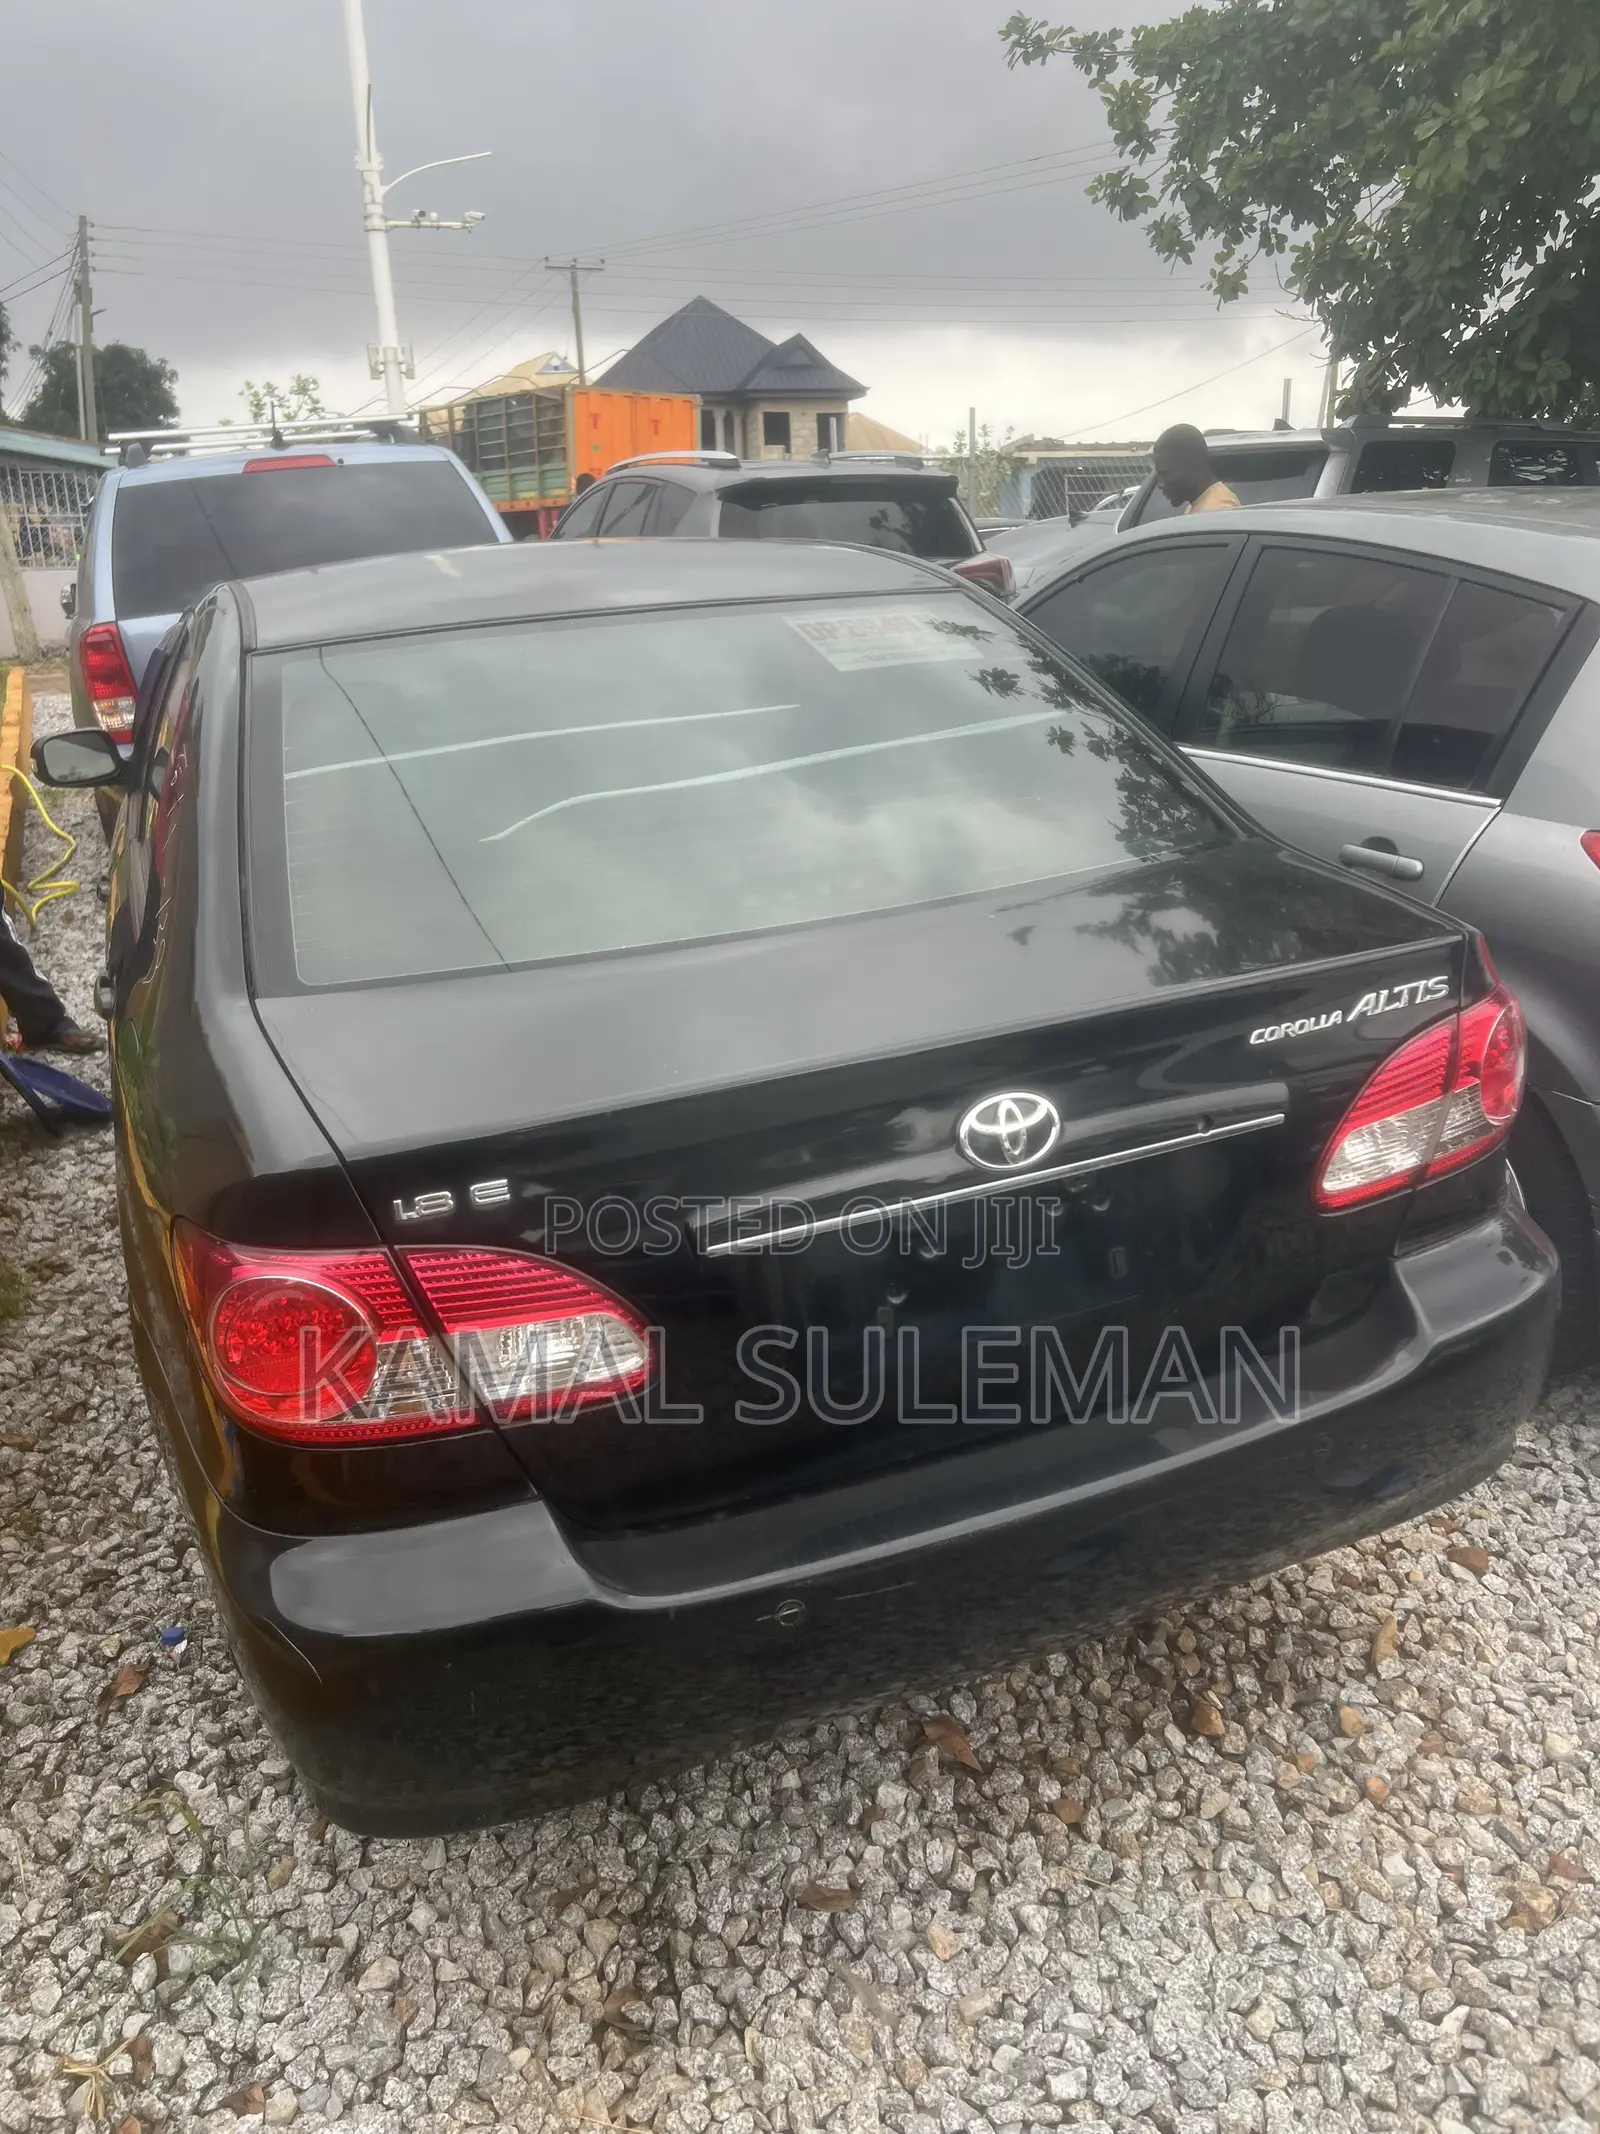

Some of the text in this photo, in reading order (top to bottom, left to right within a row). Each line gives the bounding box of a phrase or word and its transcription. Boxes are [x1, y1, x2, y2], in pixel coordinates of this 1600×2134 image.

[1249, 975, 1450, 1045] COROLLA ALTIS
[470, 1178, 511, 1204] E
